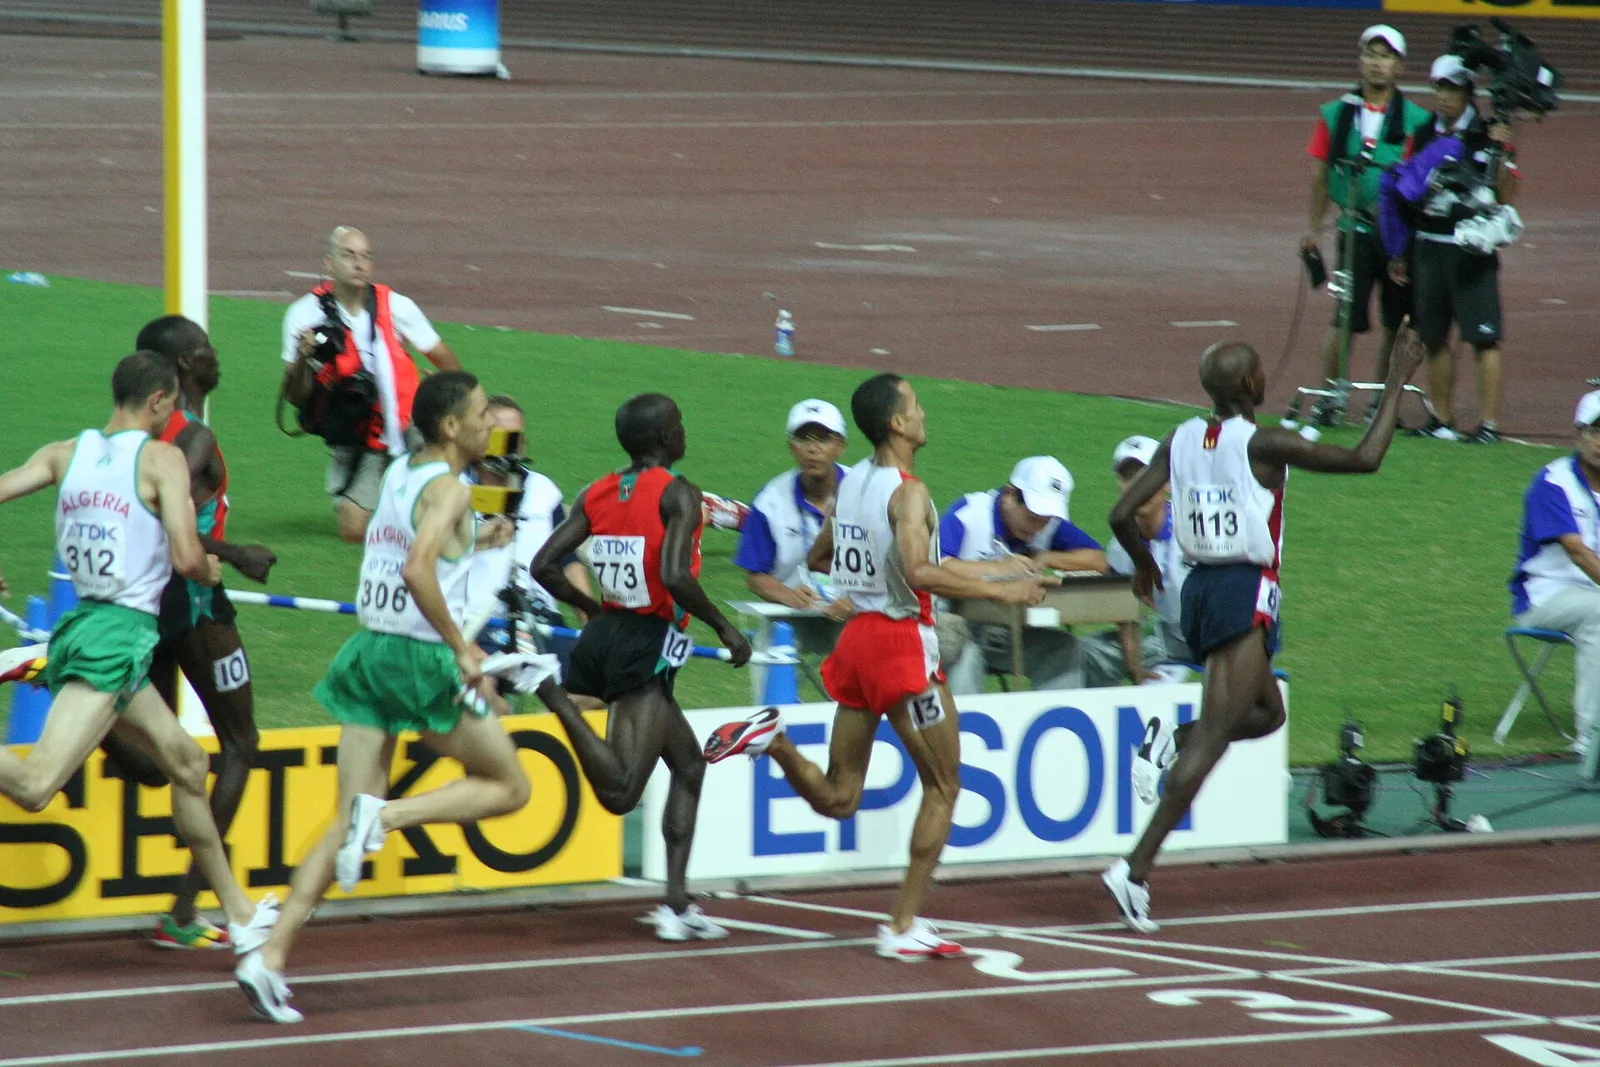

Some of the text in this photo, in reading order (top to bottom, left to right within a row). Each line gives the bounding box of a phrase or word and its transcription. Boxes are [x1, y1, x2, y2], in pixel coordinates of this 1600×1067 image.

[61, 490, 131, 519] ALGERIA
[1194, 489, 1235, 506] TDK
[75, 522, 117, 542] TDK
[367, 525, 411, 551] ALGERI
[839, 523, 870, 543] TDK
[1188, 510, 1239, 537] 1113
[66, 545, 115, 577] 312
[603, 539, 637, 556] TDK
[593, 562, 638, 590] 773
[361, 580, 410, 613] 306
[666, 631, 690, 662] 14
[221, 656, 245, 686] 10
[913, 694, 941, 724] 13
[753, 702, 1194, 858] EPSON
[1145, 988, 1394, 1024] 3
